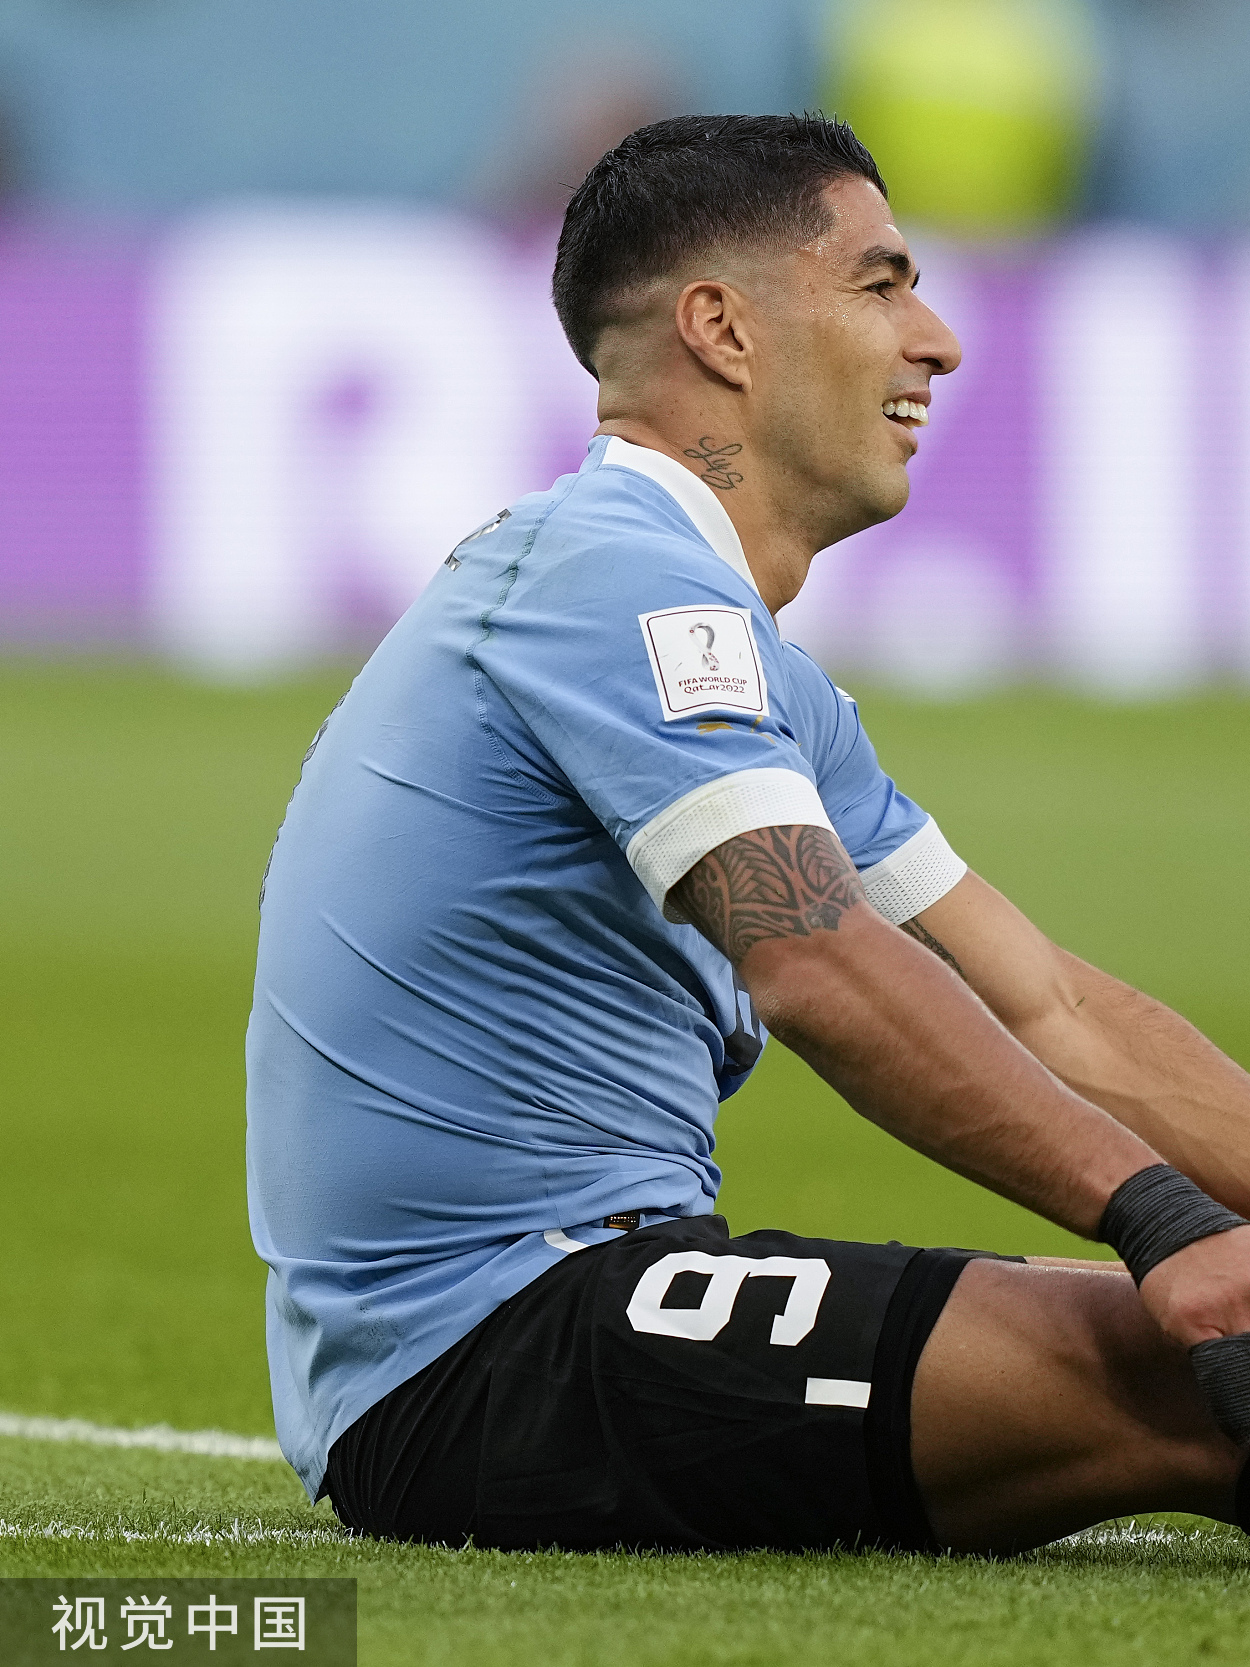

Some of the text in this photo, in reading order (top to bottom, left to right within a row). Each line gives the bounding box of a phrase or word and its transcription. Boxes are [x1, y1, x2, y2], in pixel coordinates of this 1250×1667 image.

[678, 678, 698, 687] FIFA
[732, 677, 747, 685] CUP
[626, 1250, 832, 1347] 9
